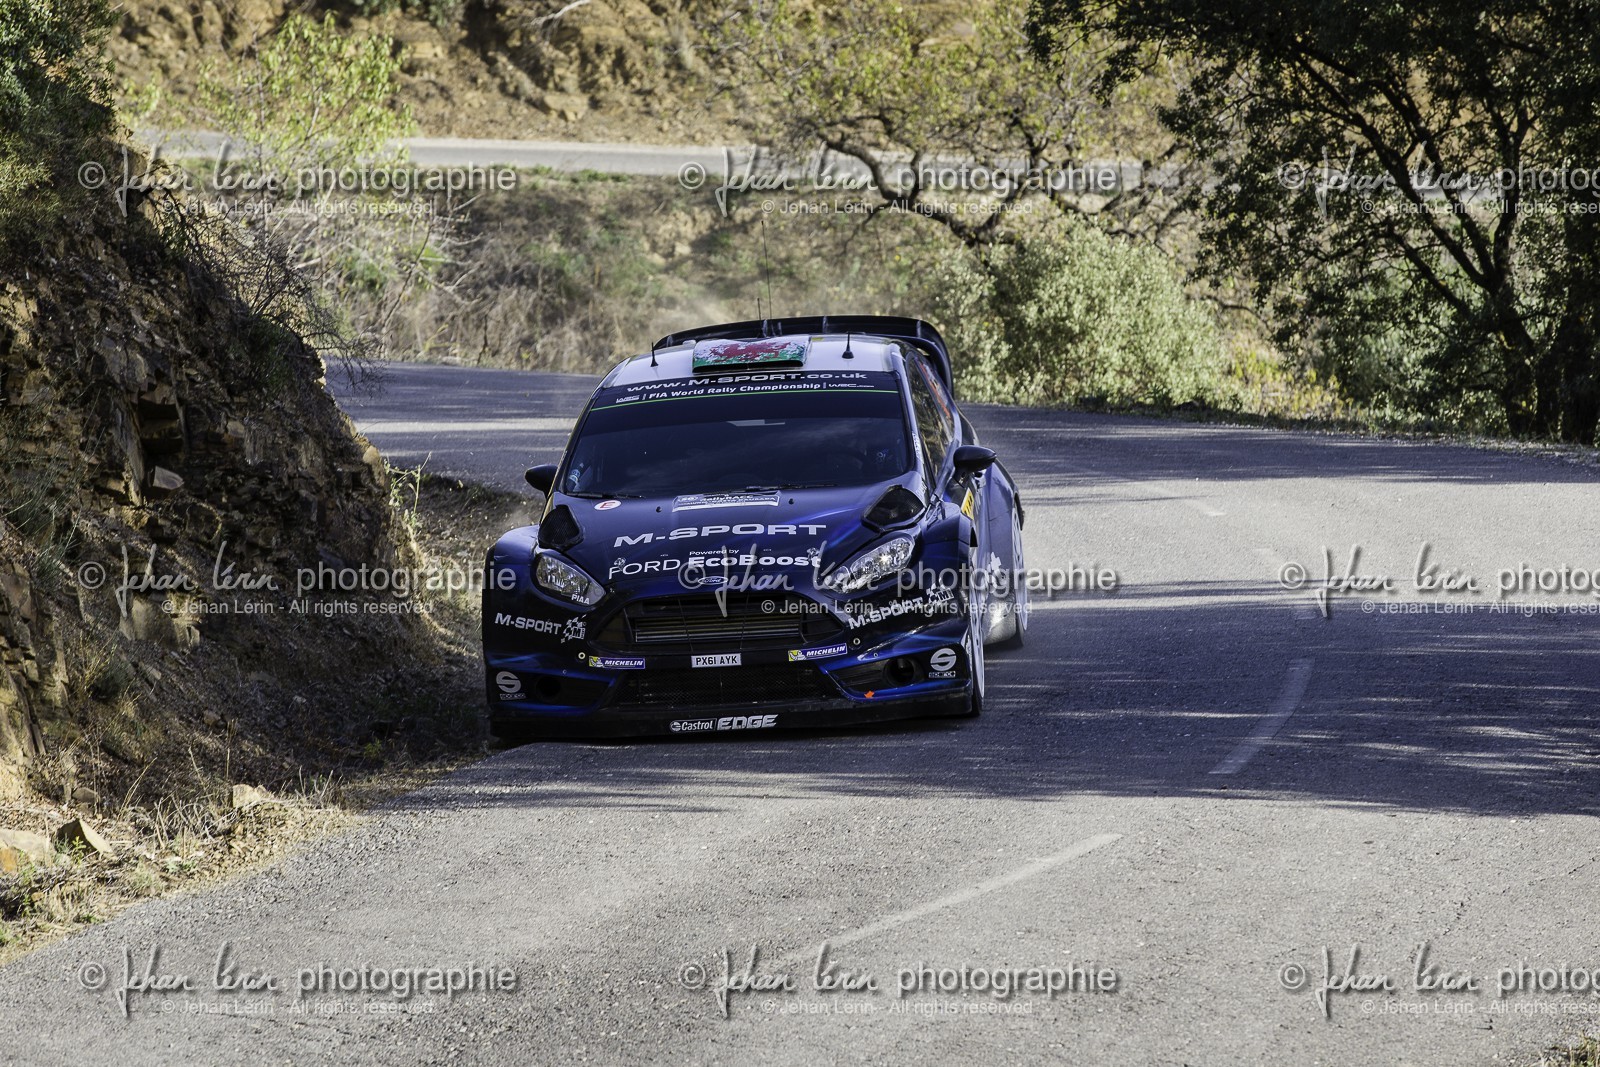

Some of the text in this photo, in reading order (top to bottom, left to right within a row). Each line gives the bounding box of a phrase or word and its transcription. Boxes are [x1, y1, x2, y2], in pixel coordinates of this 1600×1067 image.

[626, 372, 868, 392] www.M-SPORT.co.uk
[648, 392, 668, 400] FIA
[671, 387, 705, 397] World
[707, 386, 737, 394] Rally
[739, 382, 821, 392] Championship
[613, 523, 827, 548] M-SPORT
[730, 548, 740, 556] by
[608, 554, 821, 580] FORD EcoBoost
[571, 594, 590, 605] PIAA
[494, 612, 562, 635] M-SPORT
[695, 655, 738, 666] PX61 AYK
[806, 645, 846, 658] MICHELIN
[604, 659, 643, 667] MICHELIN
[681, 713, 779, 731] Castrol EDGE
